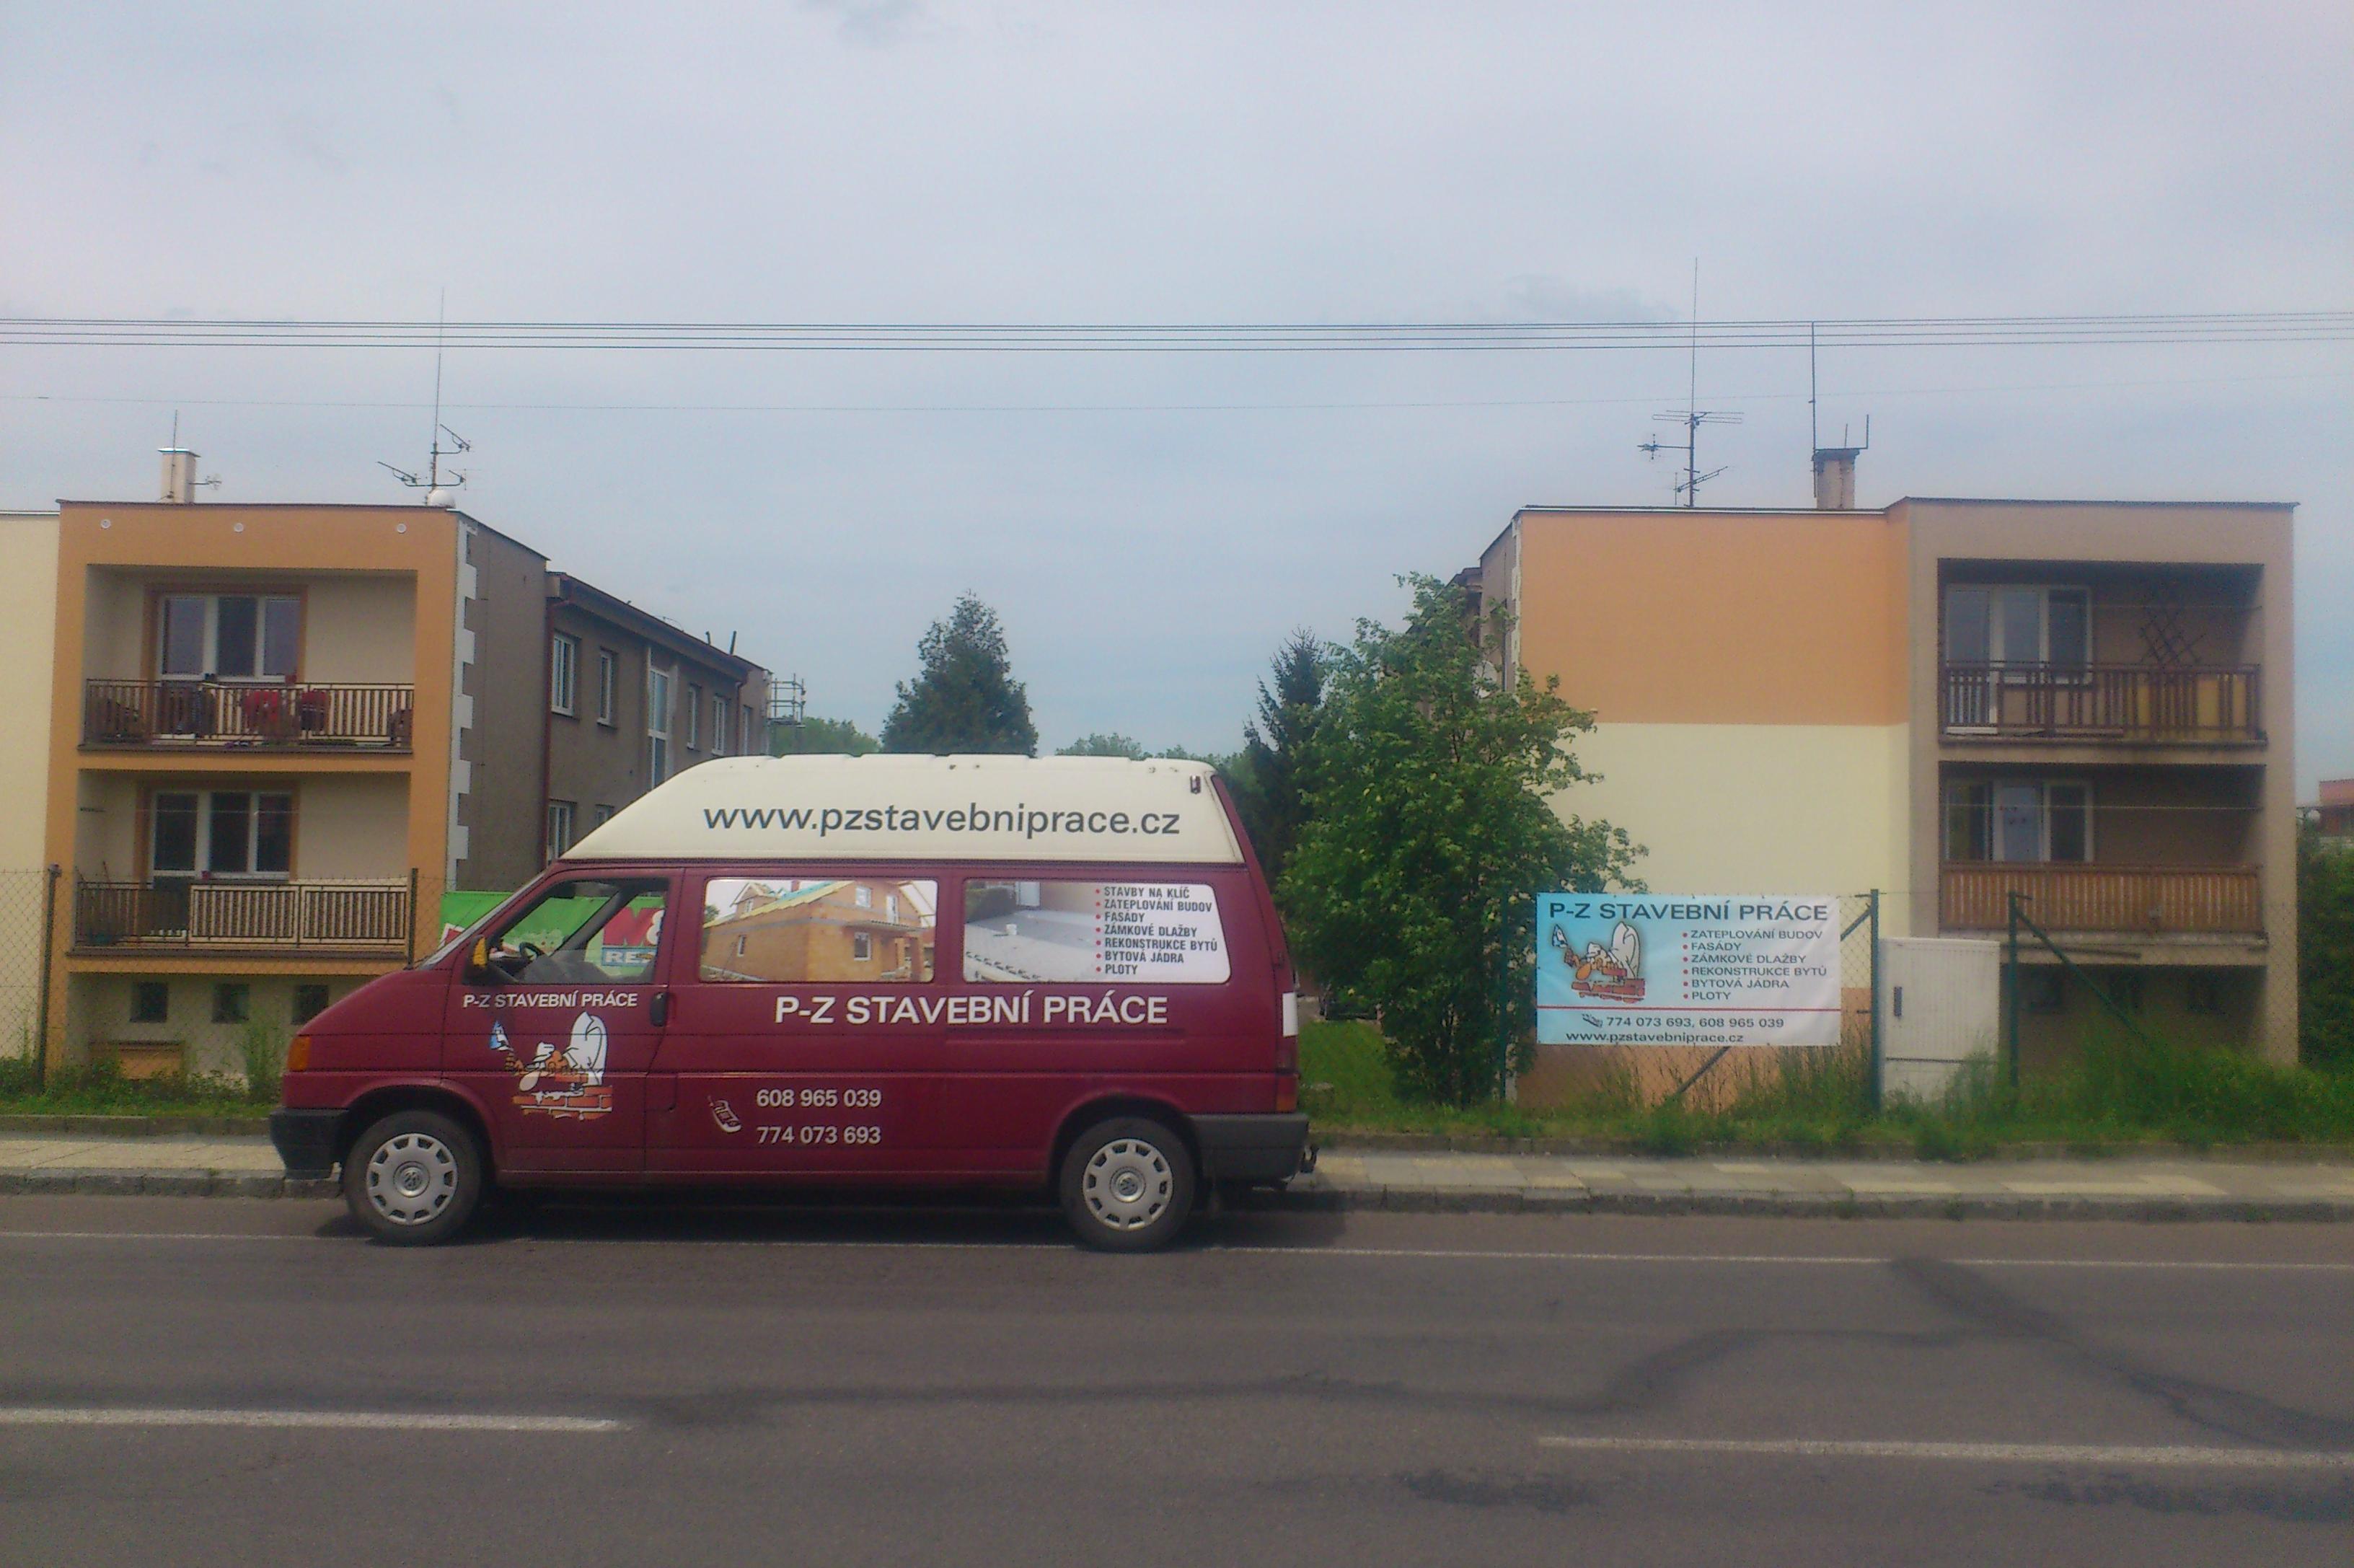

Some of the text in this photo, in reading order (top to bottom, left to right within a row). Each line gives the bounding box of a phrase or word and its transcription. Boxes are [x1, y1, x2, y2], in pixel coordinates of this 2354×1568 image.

[703, 802, 1181, 838] www.pzstavebniprace.cz
[1104, 886, 1190, 898] STAVBY NA KLÍČ
[1105, 899, 1212, 912] ZATEPLOVÁNÍ BUDOV
[1549, 900, 1828, 921] P-Z STAVEBNÍ PRÁCE
[1105, 910, 1145, 922] FASÁDY
[1105, 923, 1197, 937] ZÁMKOVÉ DLAŽBY
[1690, 927, 1823, 940] ZATEPLOVÁNÍ BUDOV
[1105, 938, 1217, 951] REKONSTRUKCE BYTŮ
[1690, 940, 1742, 951] FASÁDY
[1105, 951, 1184, 963] BYTOVÁ JÁDRA
[1690, 952, 1807, 964] ZÁMKOVÉ DLAŽBY
[1105, 964, 1138, 974] PLOTY
[1691, 966, 1827, 976] REKONSTRUKCE BYTŮ
[1691, 977, 1789, 988] BYTOVÁ JÁDRA
[462, 990, 638, 1008] P-Z STAVEBNÍ PRÁCE
[1691, 991, 1731, 1000] PLOTY
[774, 989, 1169, 1025] P-Z STAVEBNÍ PRÁCE
[1606, 1017, 1784, 1029] 774 073 693, 608 965 039
[1566, 1031, 1744, 1044] www.pzstavebniprace.cz
[755, 1089, 883, 1109] 608 965 039
[755, 1126, 883, 1145] 774 073 693
